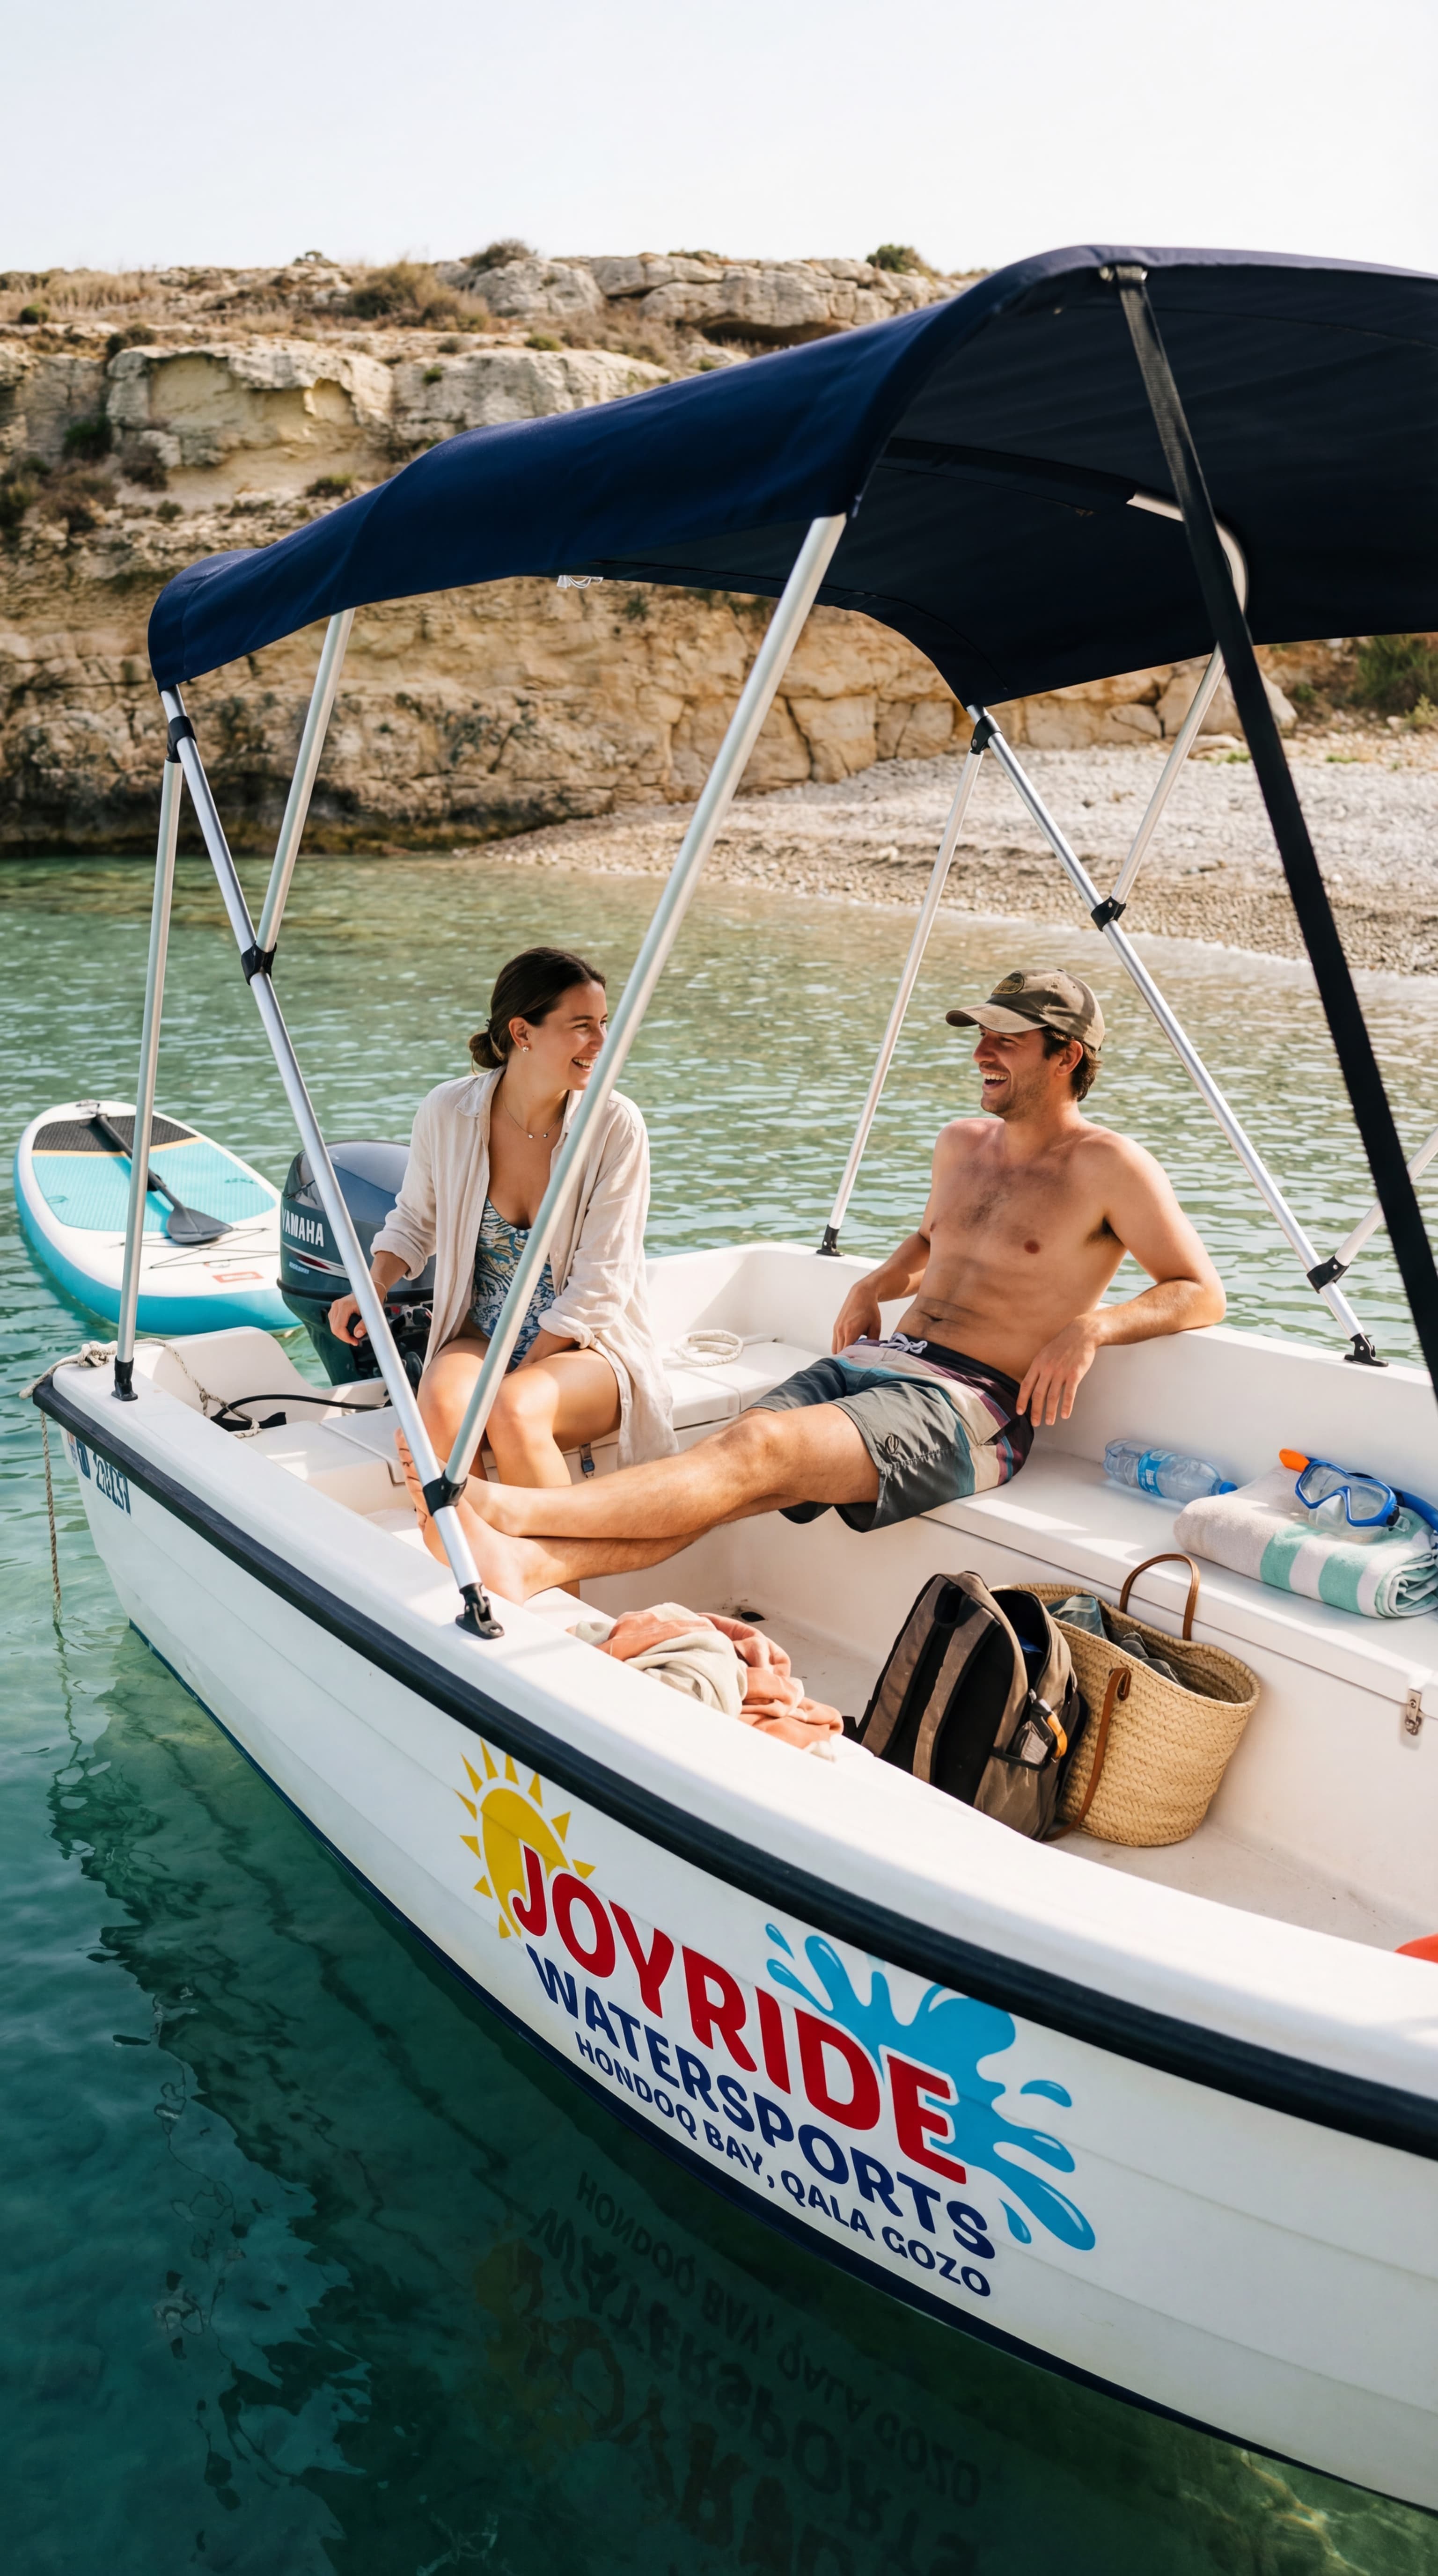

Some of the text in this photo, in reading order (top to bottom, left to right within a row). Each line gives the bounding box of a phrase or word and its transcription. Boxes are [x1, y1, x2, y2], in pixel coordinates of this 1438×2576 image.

[282, 1208, 324, 1247] YAMAHA
[512, 1845, 967, 2185] JOYRIDE
[526, 1943, 996, 2260] WATERSPORTS
[575, 2031, 991, 2297] HONDOQ BAY, QALA GOZO
